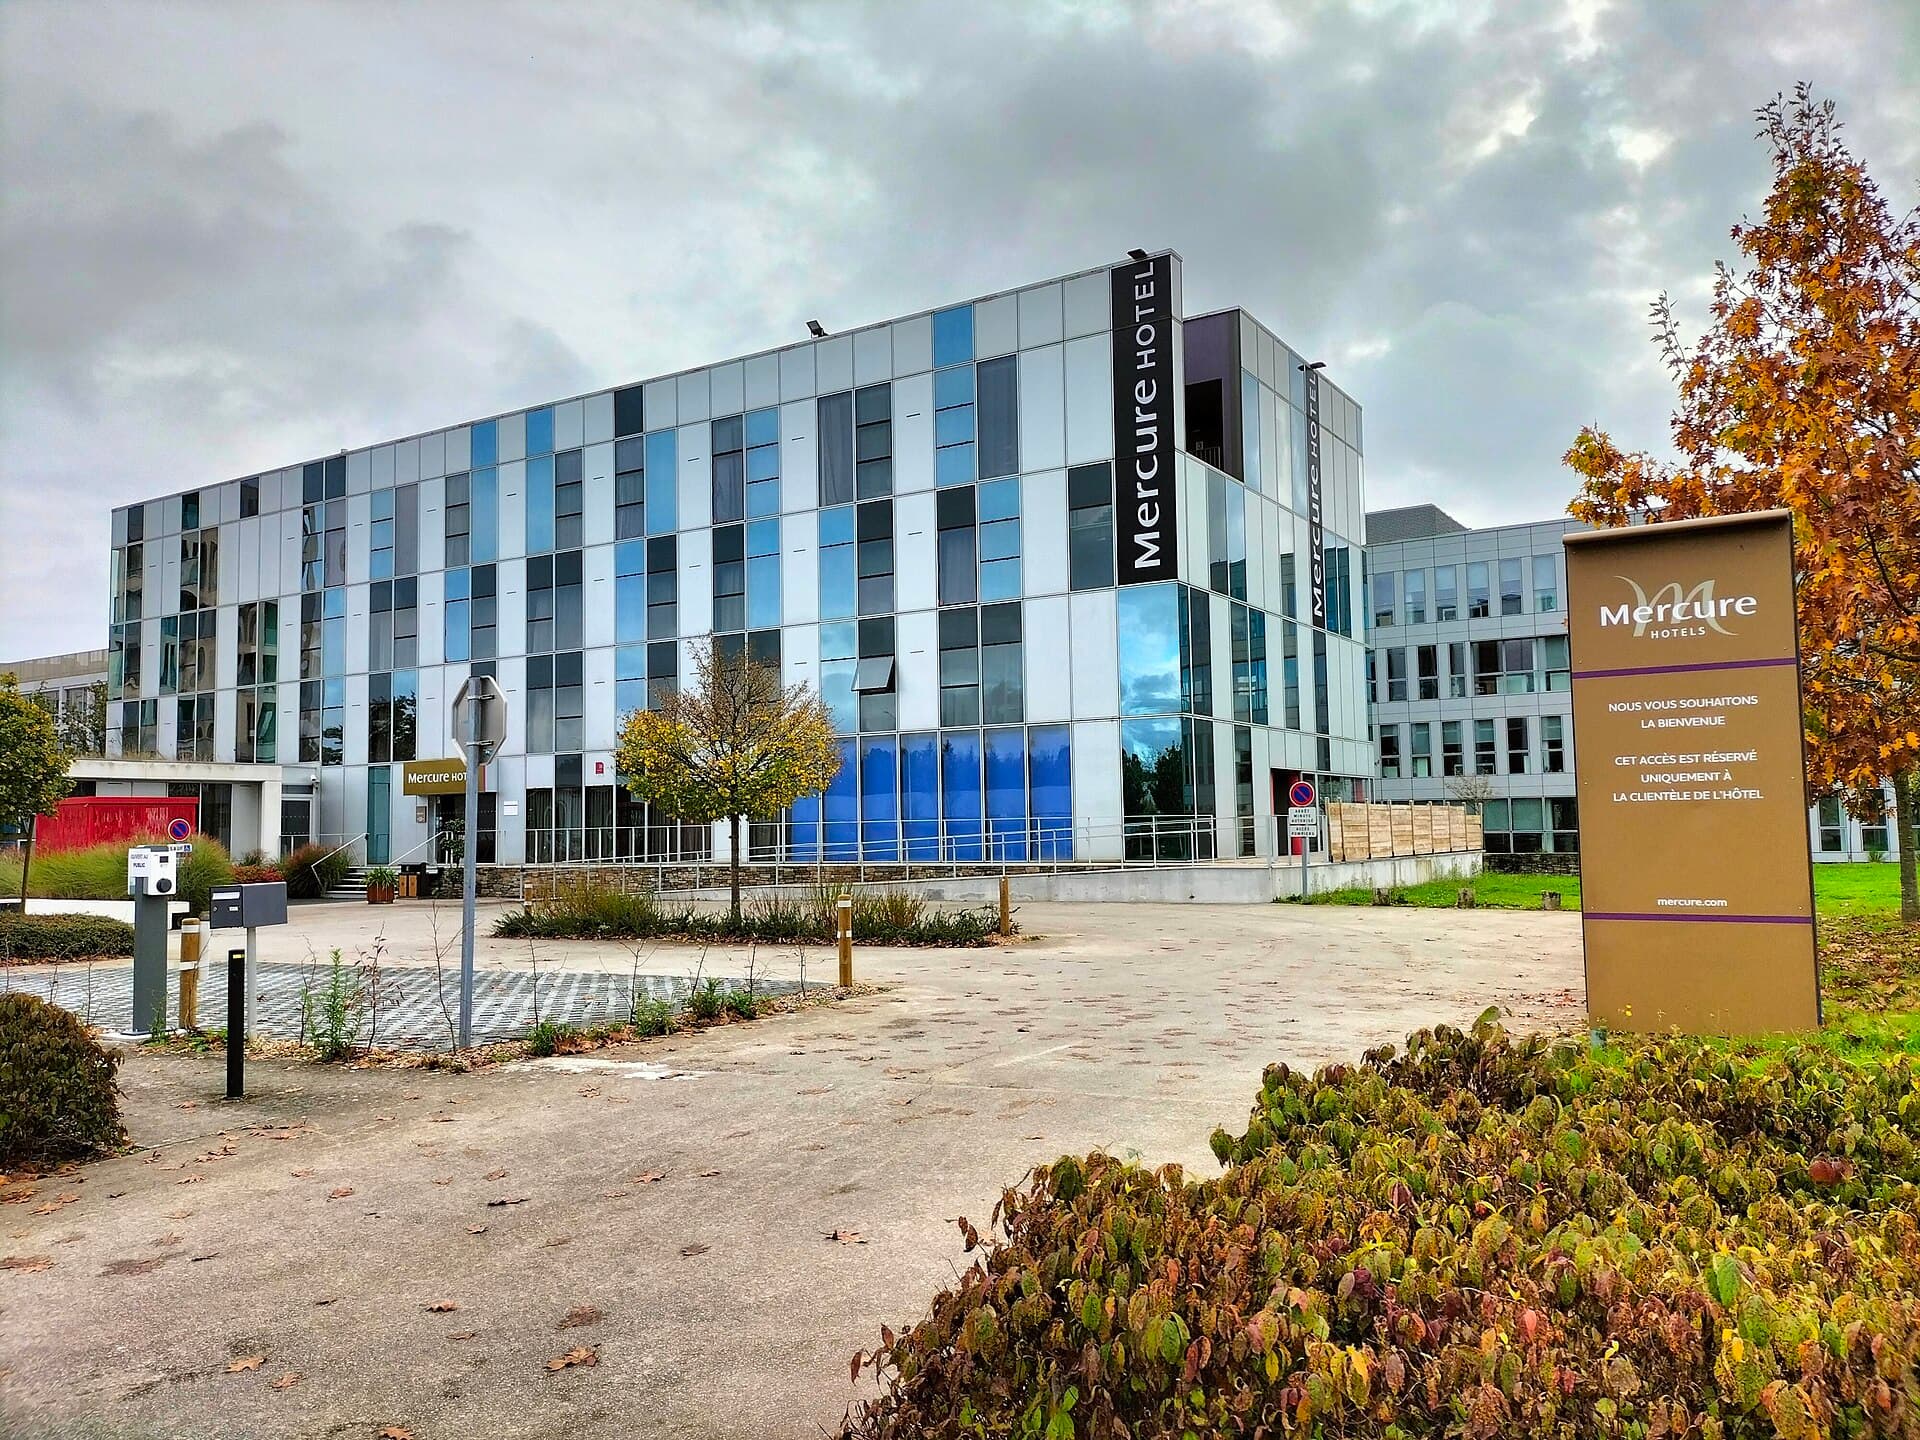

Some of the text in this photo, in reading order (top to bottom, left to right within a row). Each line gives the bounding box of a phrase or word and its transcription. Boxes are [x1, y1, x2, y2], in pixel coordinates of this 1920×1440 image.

[1133, 261, 1161, 570] Mercure HOTEL
[1308, 369, 1324, 617] Mercure HOTEL
[1600, 595, 1757, 627] Mercure
[1650, 626, 1706, 639] HOTELS
[1608, 696, 1759, 712] NOUS VOUS SOUHAITONS
[1641, 716, 1725, 729] LA BIENVENUE
[1615, 748, 1758, 766] CET ACCÈS EST RÉSERVÉ
[408, 772, 450, 784] Mercure
[1640, 769, 1732, 784] UNIQUEMENT À
[1613, 787, 1764, 802] LA CLIENTÈLE DE L'HÔTEL
[1657, 898, 1728, 907] mercure.com
